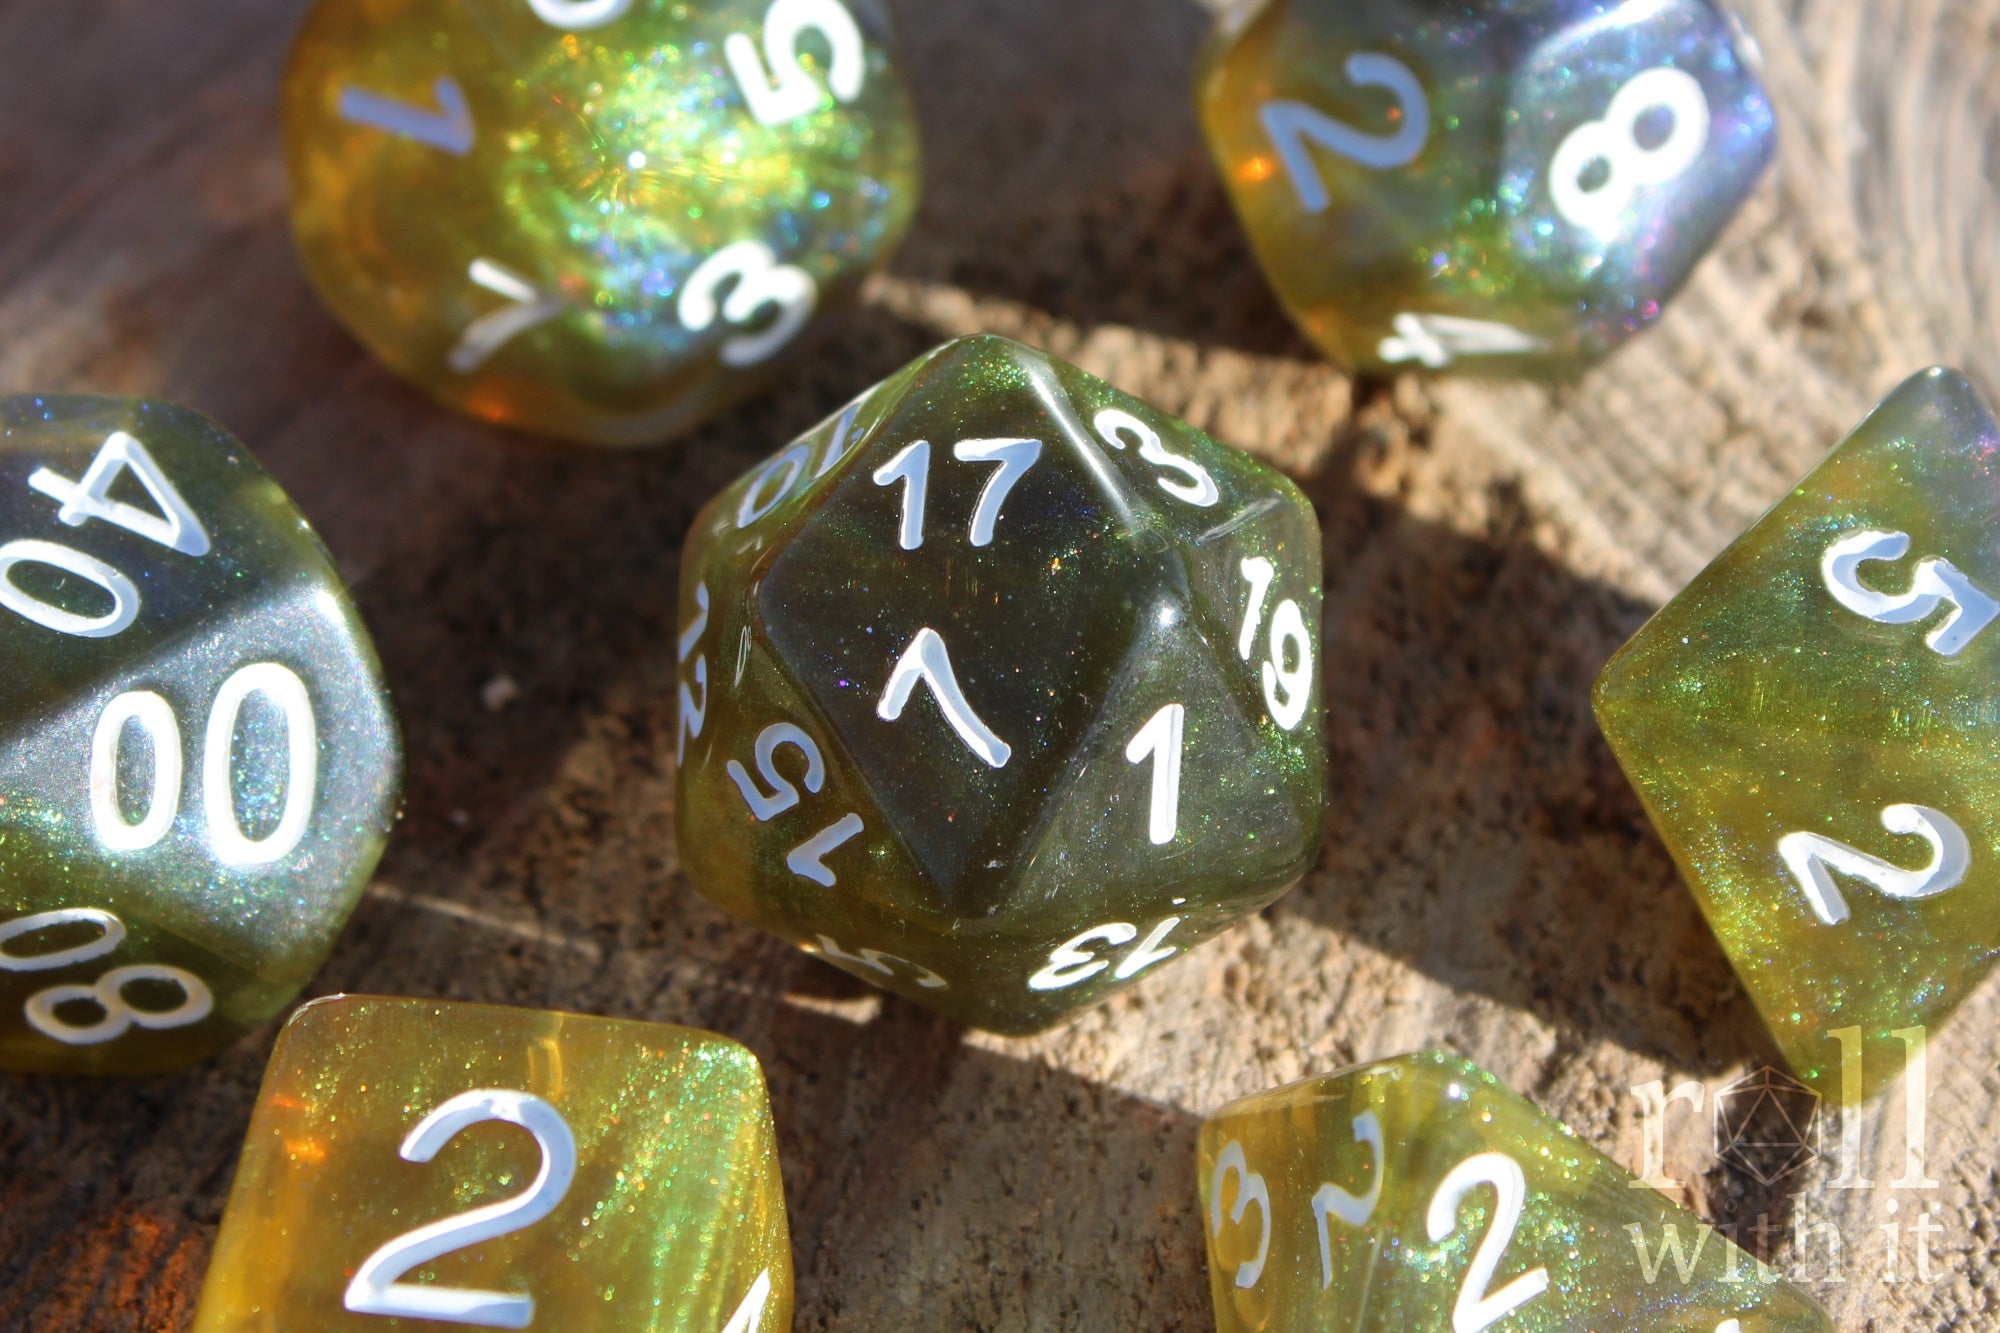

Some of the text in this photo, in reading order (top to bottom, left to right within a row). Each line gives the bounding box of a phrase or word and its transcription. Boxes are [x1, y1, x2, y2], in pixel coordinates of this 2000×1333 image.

[725, 0, 864, 127] 5
[1261, 52, 1429, 212] 2
[1549, 67, 1709, 238] 8
[677, 241, 816, 366] 3
[1377, 312, 1555, 367] 4
[873, 437, 1042, 551] 17
[1094, 409, 1220, 508] 3
[1239, 556, 1315, 731] 19
[1821, 527, 2000, 656] 5
[90, 662, 317, 866] 00
[1126, 703, 1185, 845] 1
[1778, 803, 1970, 926] 2
[344, 1088, 576, 1330] 2
[1212, 1140, 1271, 1289] 3
[1427, 1153, 1550, 1333] 2
